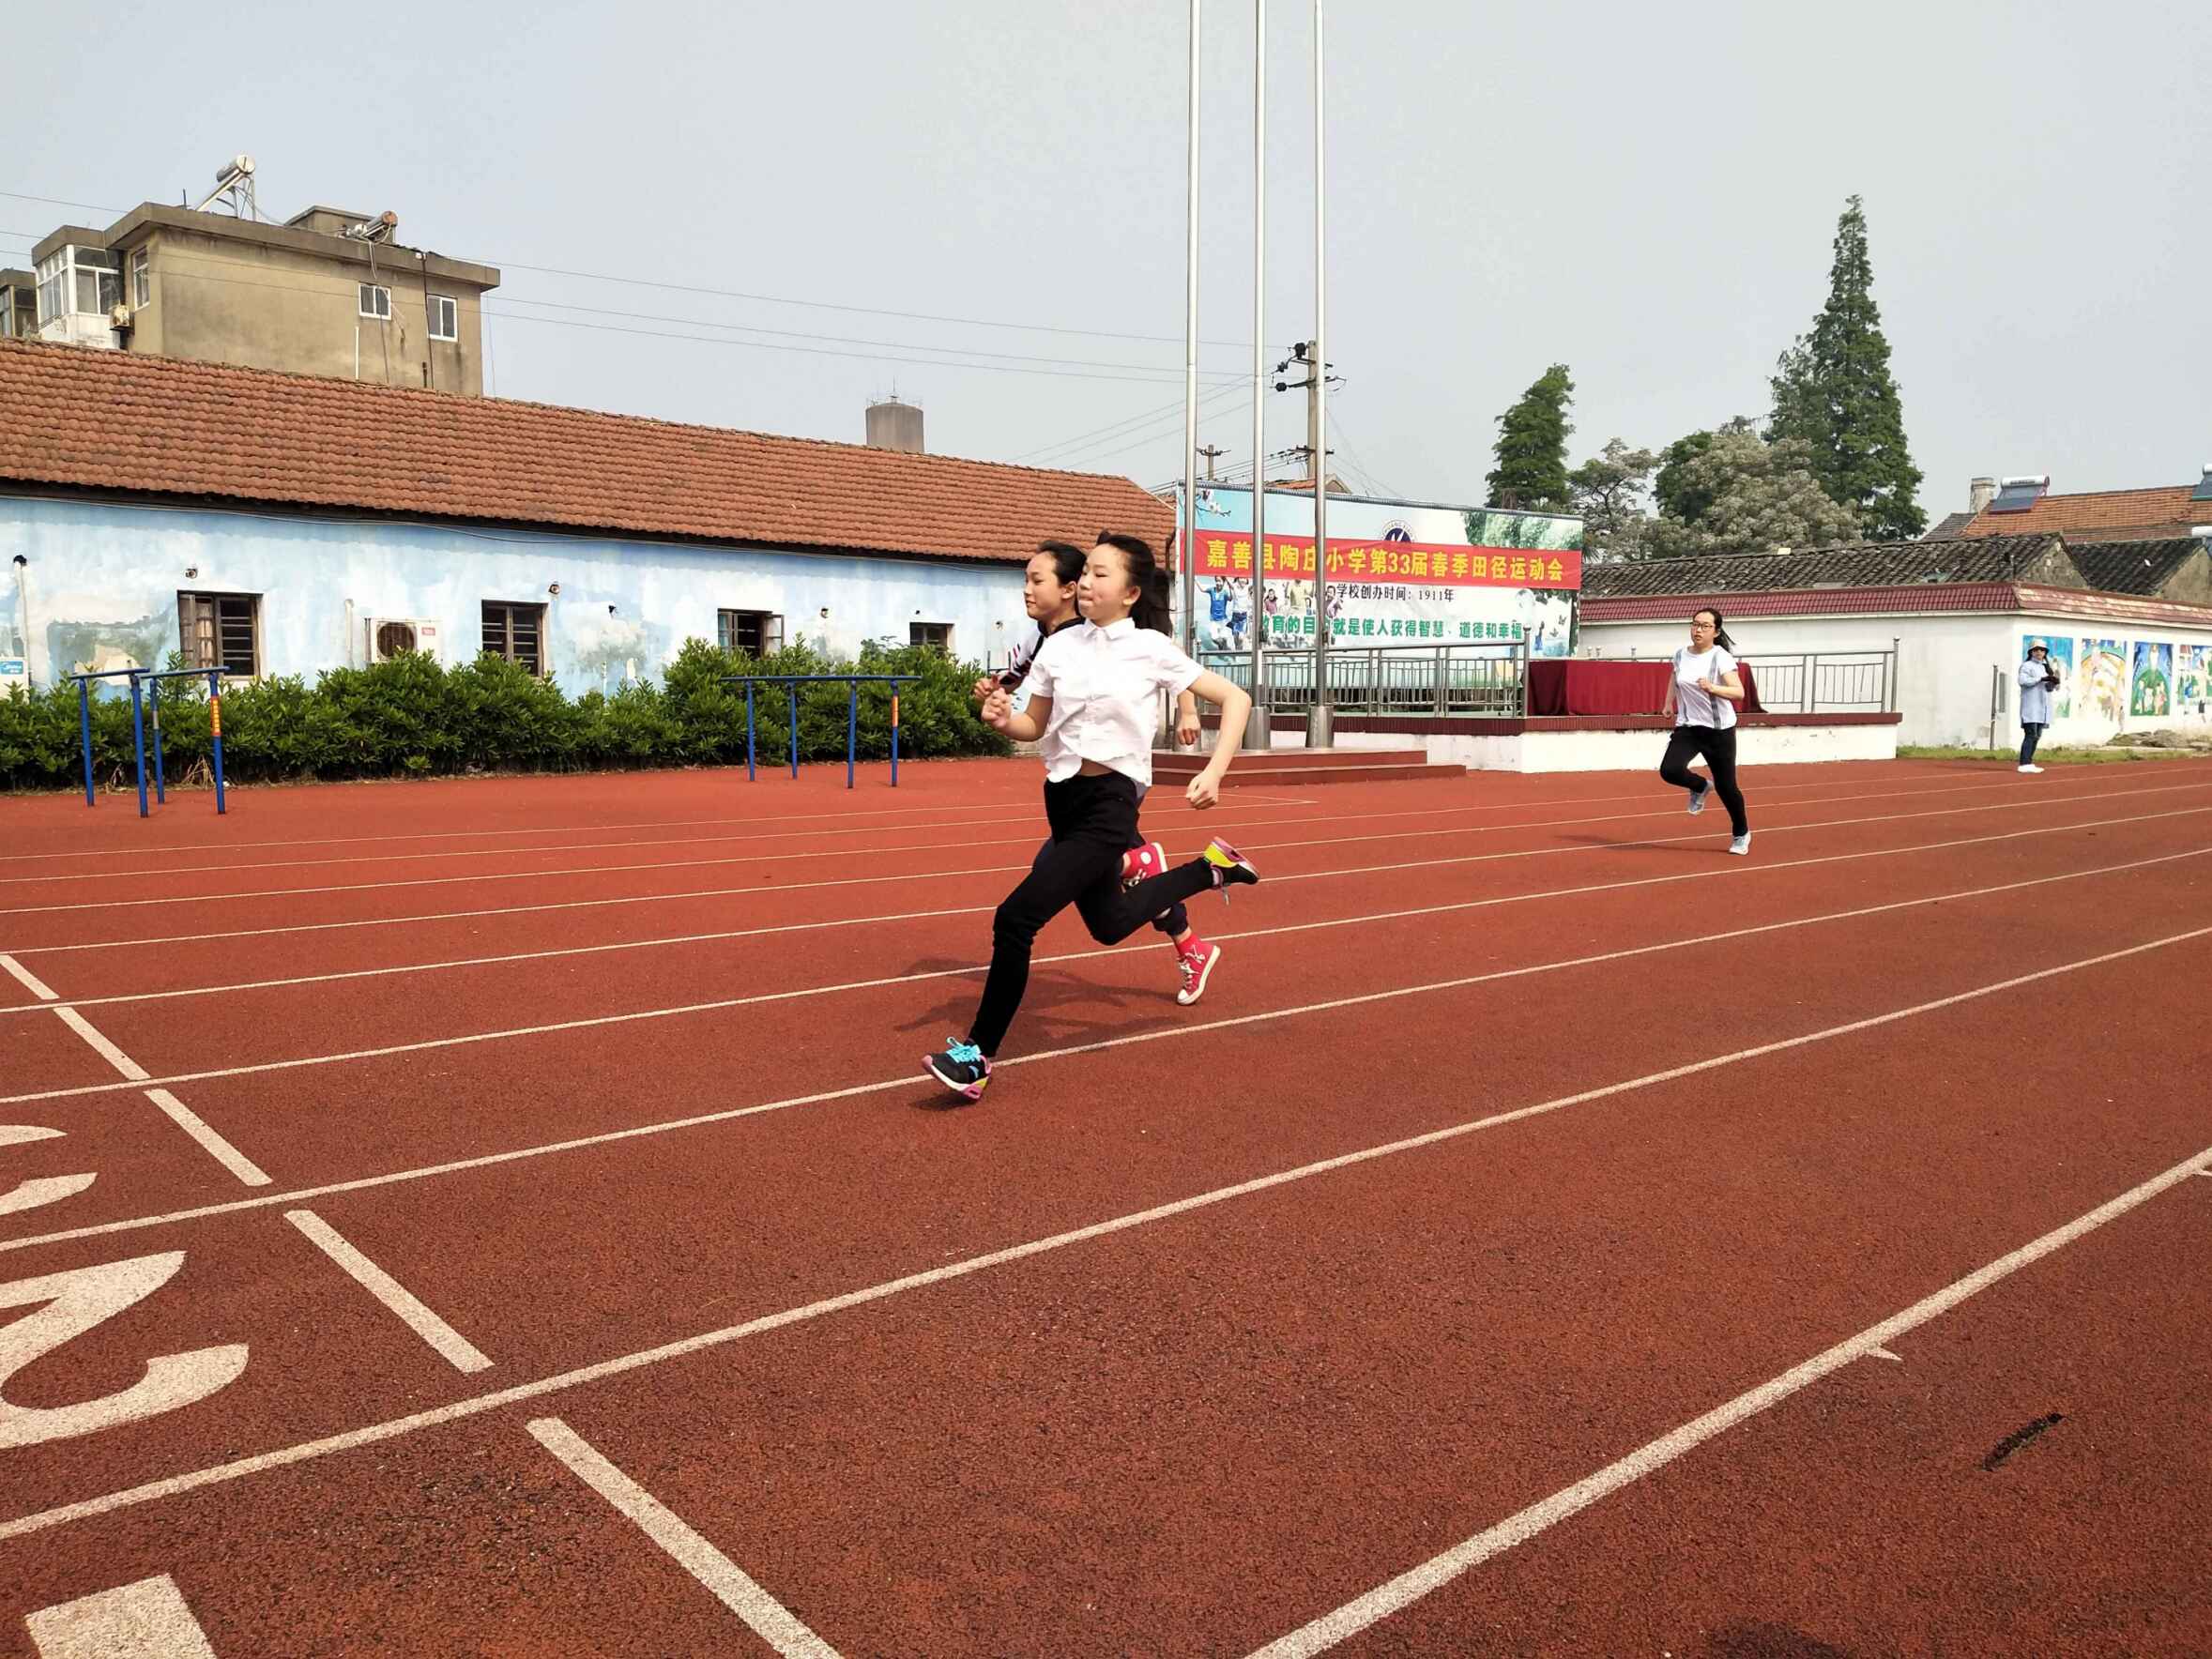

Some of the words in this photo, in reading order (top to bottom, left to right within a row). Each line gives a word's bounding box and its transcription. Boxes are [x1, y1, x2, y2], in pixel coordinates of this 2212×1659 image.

[1207, 540, 1563, 581] 嘉善县陶庄小学第33届春季田径运动会
